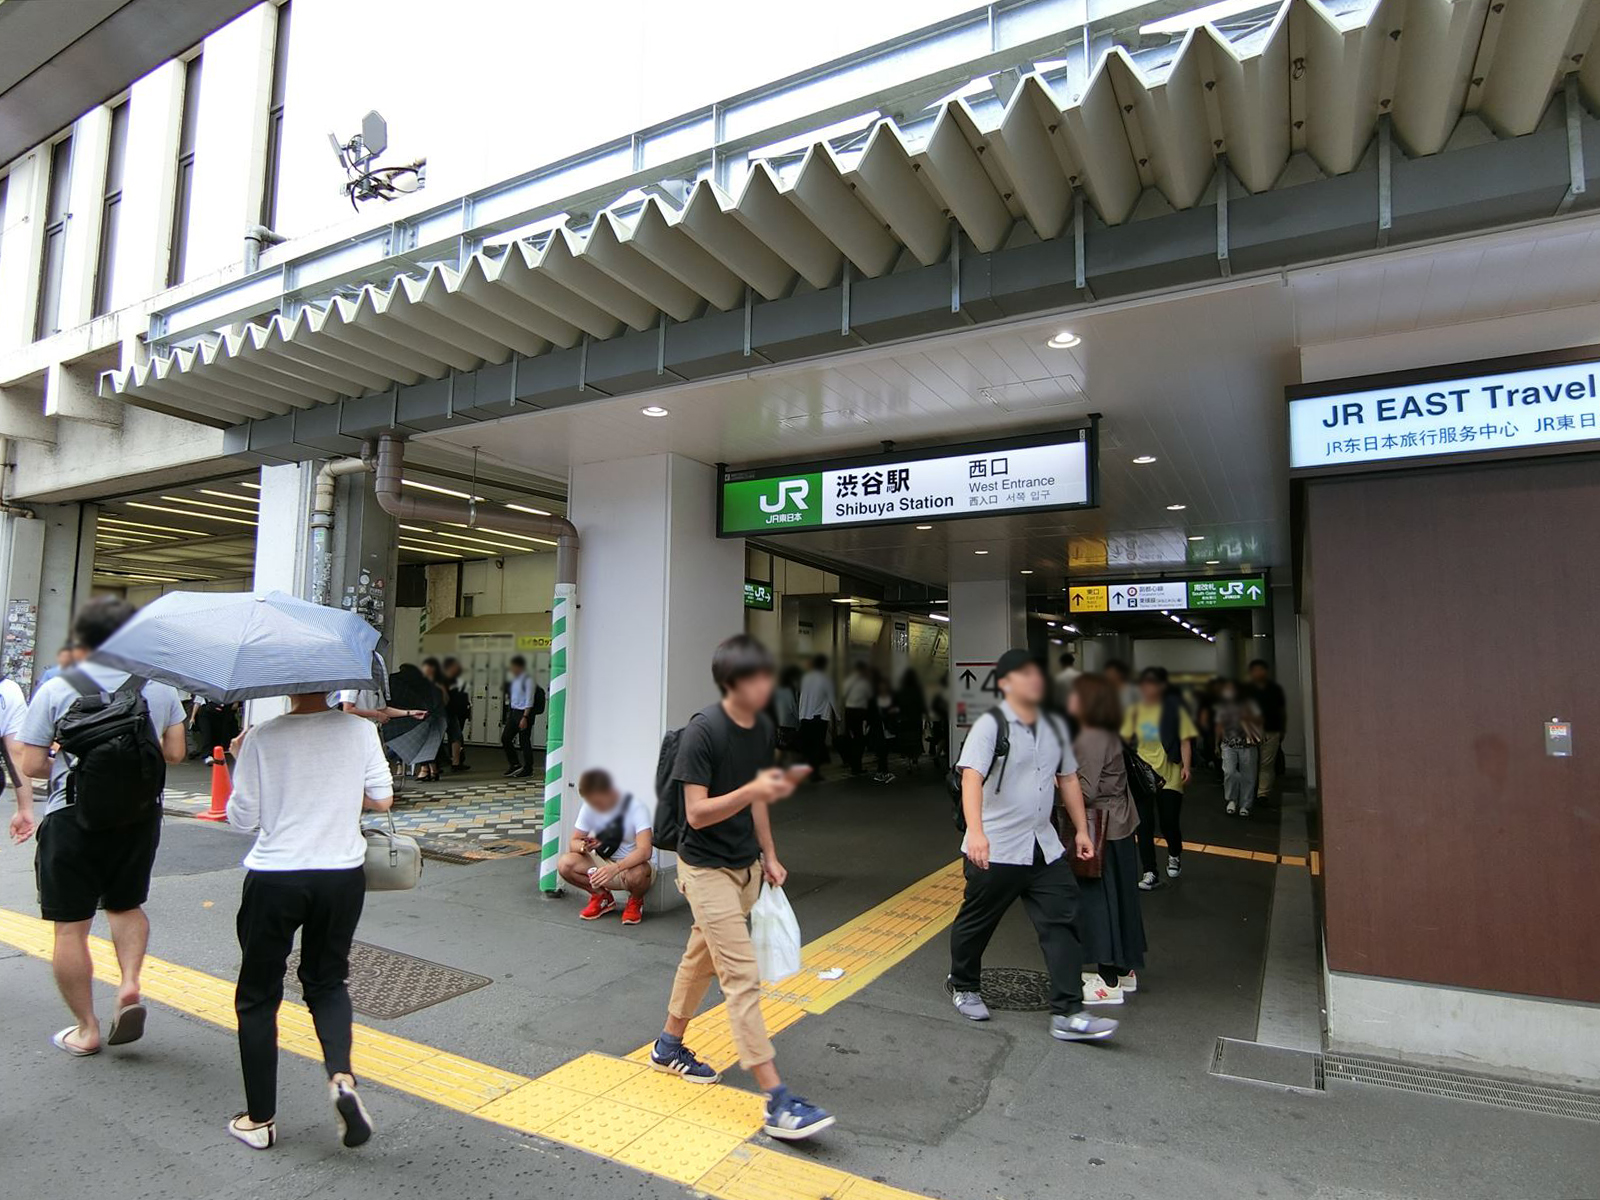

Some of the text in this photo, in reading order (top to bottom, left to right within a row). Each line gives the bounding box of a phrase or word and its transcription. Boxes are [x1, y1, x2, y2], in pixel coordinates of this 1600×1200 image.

[1322, 373, 1597, 428] JR EAST Travel
[1326, 421, 1520, 457] JR东日本旅行服务中心
[968, 457, 1009, 479] 西口
[836, 468, 910, 498] 渋谷駅
[968, 476, 1055, 493] West Entrance
[759, 479, 809, 513] JR
[835, 495, 954, 517] Shibuya Station
[969, 495, 998, 507] 西入口
[1030, 489, 1051, 501] 입구
[765, 513, 803, 524] JR東日本
[1219, 582, 1244, 596] JR
